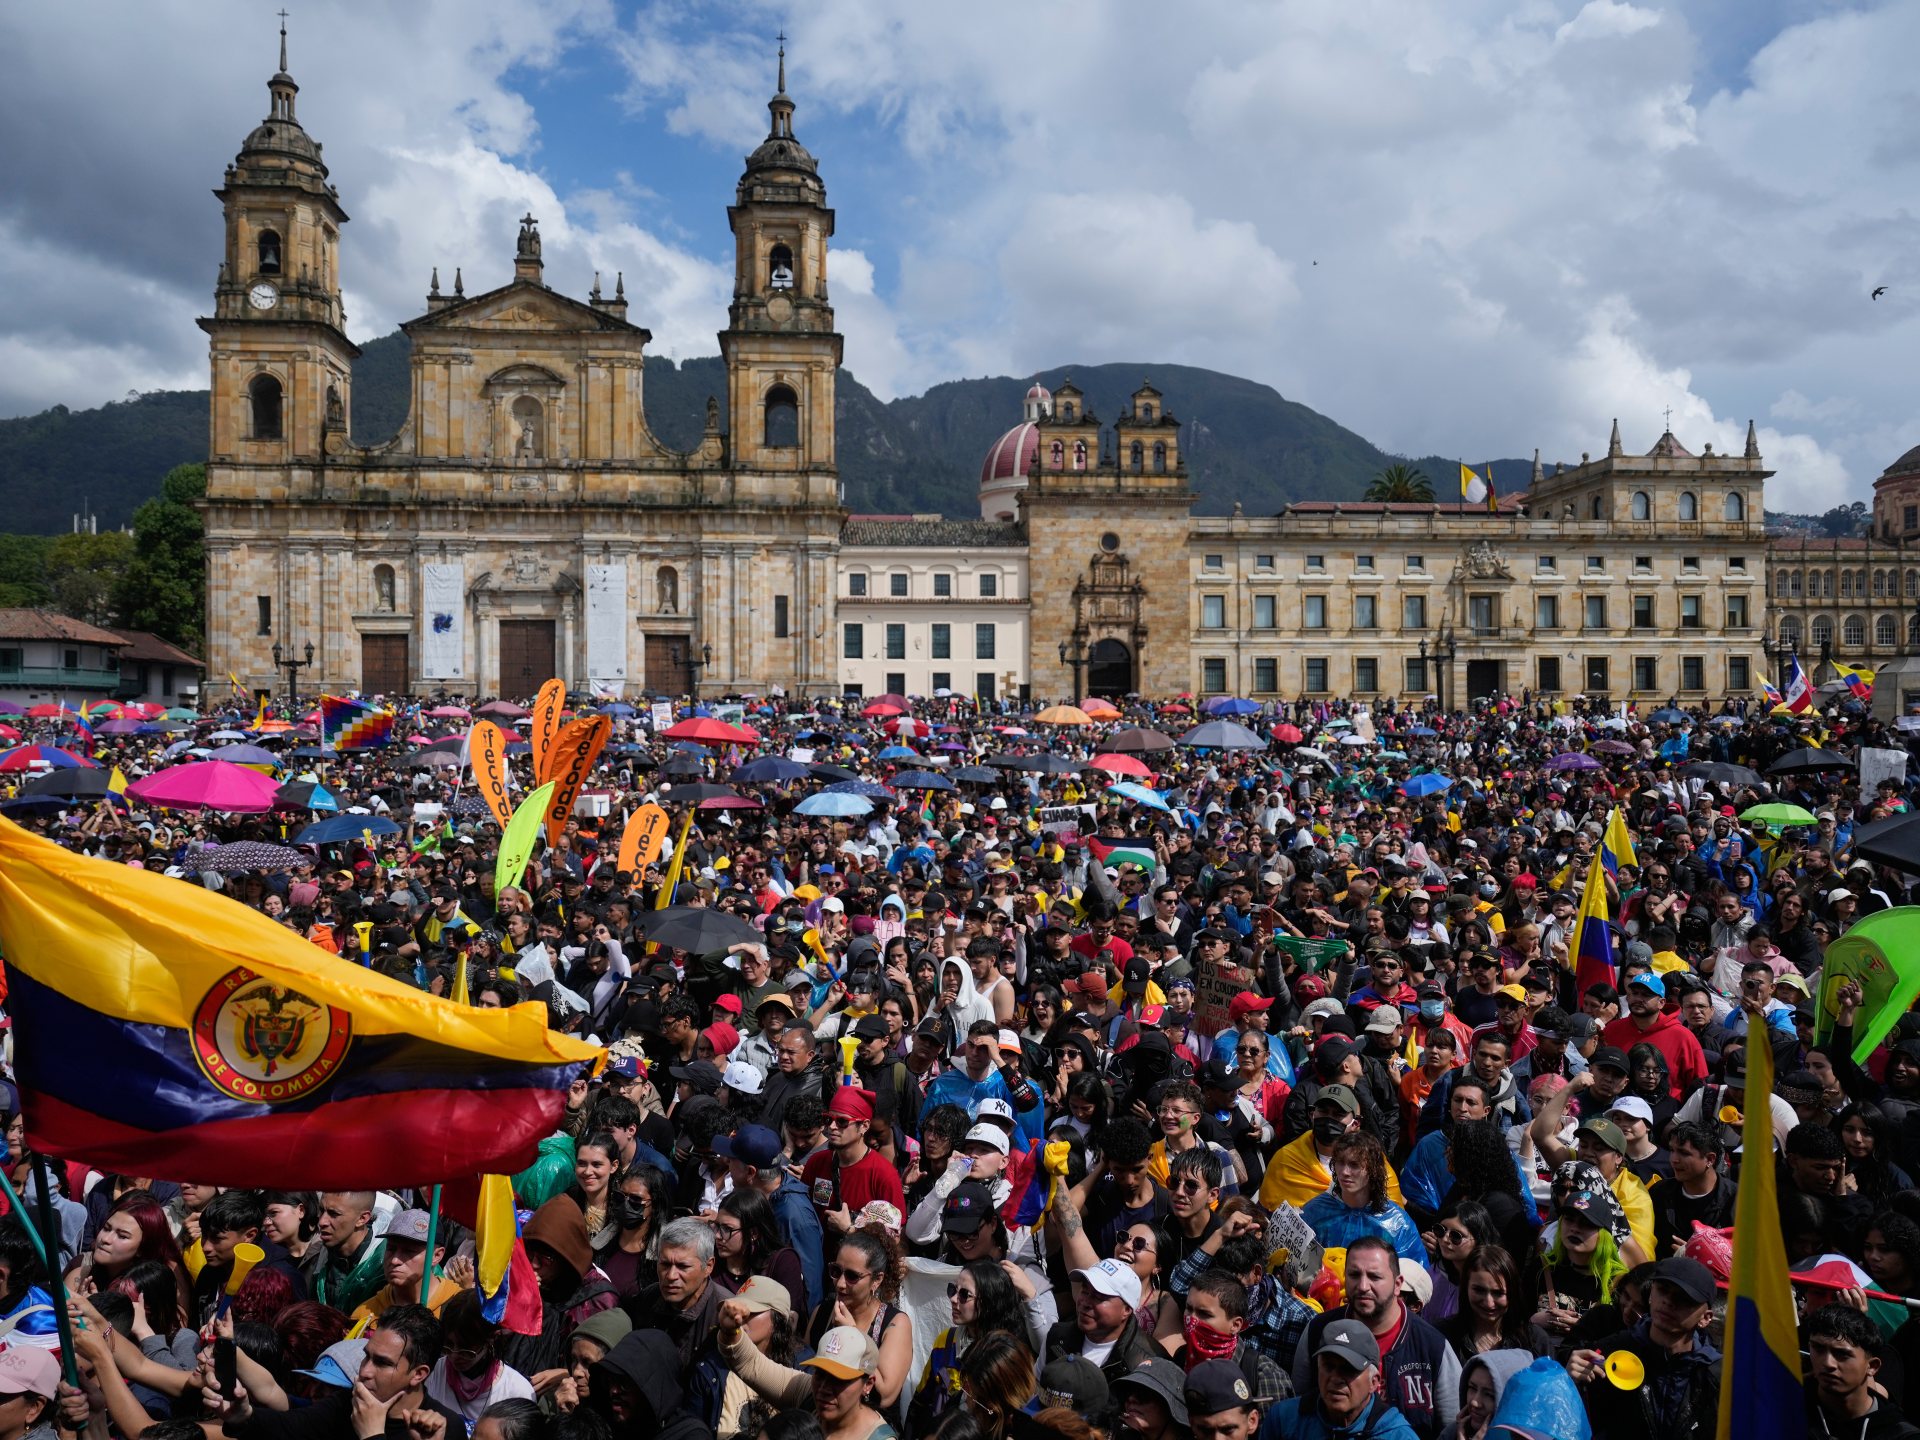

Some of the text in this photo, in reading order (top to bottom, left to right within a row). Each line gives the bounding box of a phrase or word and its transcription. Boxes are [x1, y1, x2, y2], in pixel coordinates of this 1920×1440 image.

[552, 721, 604, 821] fecode
[1201, 960, 1215, 977] LOS
[1200, 977, 1212, 989] EN
[1208, 993, 1223, 1006] SON
[207, 1053, 334, 1097] DE COLOMBIA
